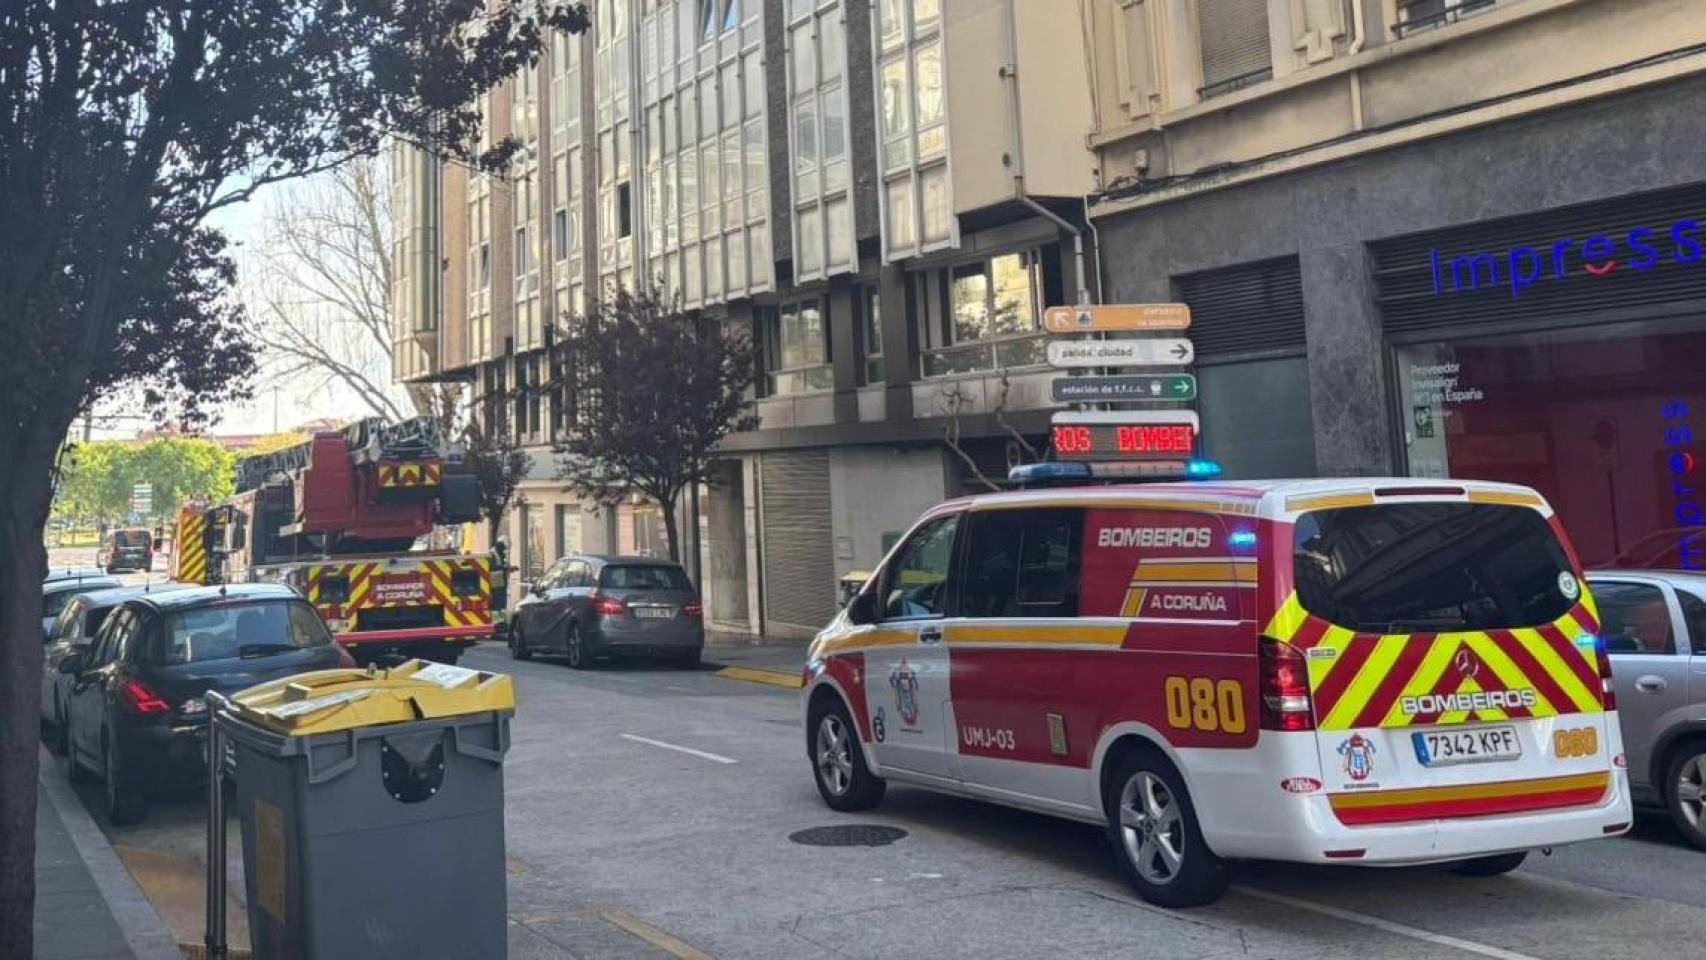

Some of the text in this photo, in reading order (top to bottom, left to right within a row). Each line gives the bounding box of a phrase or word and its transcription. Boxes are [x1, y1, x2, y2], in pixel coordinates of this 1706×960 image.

[1062, 346, 1133, 358] salida ciudad
[1410, 362, 1460, 375] Proveedor
[1061, 384, 1099, 395] estación
[1101, 384, 1113, 394] de
[1446, 387, 1484, 403] España
[1660, 396, 1706, 571] mpress
[1098, 526, 1212, 548] BOMBEIROS
[1150, 592, 1227, 612] A CORUÑA
[1165, 675, 1246, 734] 080
[1401, 688, 1537, 715] BOMBEIROS
[962, 725, 1016, 750] UMJ-03
[1428, 731, 1514, 758] 7342 KPF
[1554, 726, 1598, 757] 080
